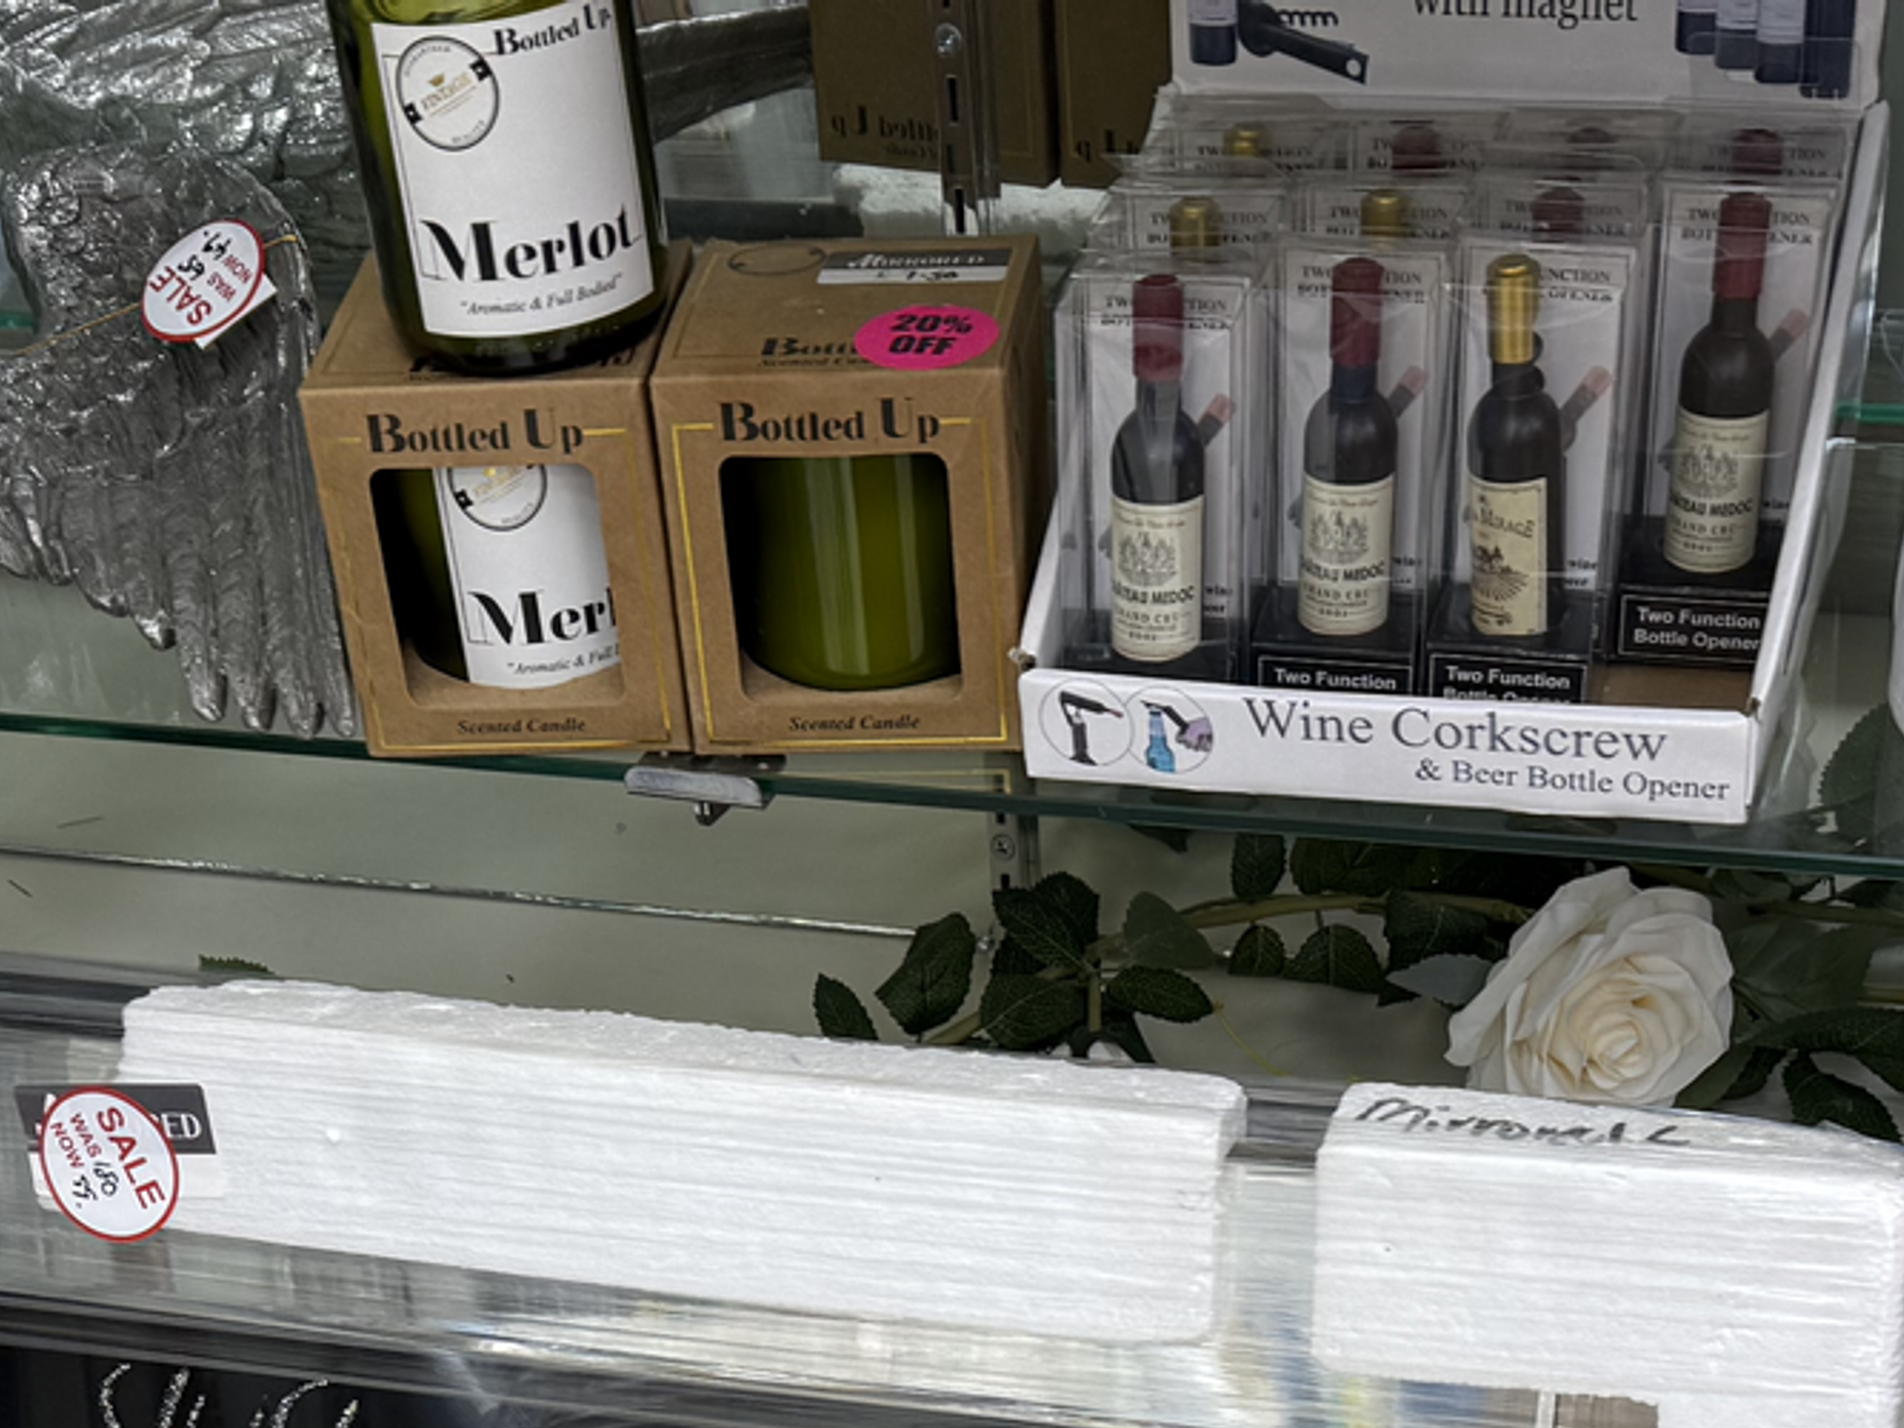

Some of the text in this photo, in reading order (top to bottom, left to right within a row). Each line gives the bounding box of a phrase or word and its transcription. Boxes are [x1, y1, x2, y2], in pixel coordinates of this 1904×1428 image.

[493, 3, 612, 56] Bottled Up
[1502, 0, 1638, 30] magnet
[419, 203, 643, 282] Merlot
[206, 271, 237, 303] WAS
[222, 254, 253, 284] NOW
[149, 266, 213, 326] SALE
[890, 314, 973, 334] 20%
[888, 336, 956, 355] OFF
[367, 408, 584, 454] Bottled Up
[720, 398, 939, 444] Bottled Up
[467, 586, 617, 646] Merl
[1637, 606, 1761, 630] Two Function
[1633, 628, 1687, 647] Bottle
[1274, 666, 1397, 691] Two Function
[1446, 665, 1571, 689] Two Function
[457, 717, 587, 735] Scented Candle
[789, 715, 921, 732] Scented Candle
[1243, 696, 1668, 762] Wine Corkscrew
[1415, 759, 1731, 803] & Beer Bottle Opener
[50, 1121, 85, 1168] NOW
[70, 1112, 102, 1159] WAS
[97, 1106, 166, 1209] SALE
